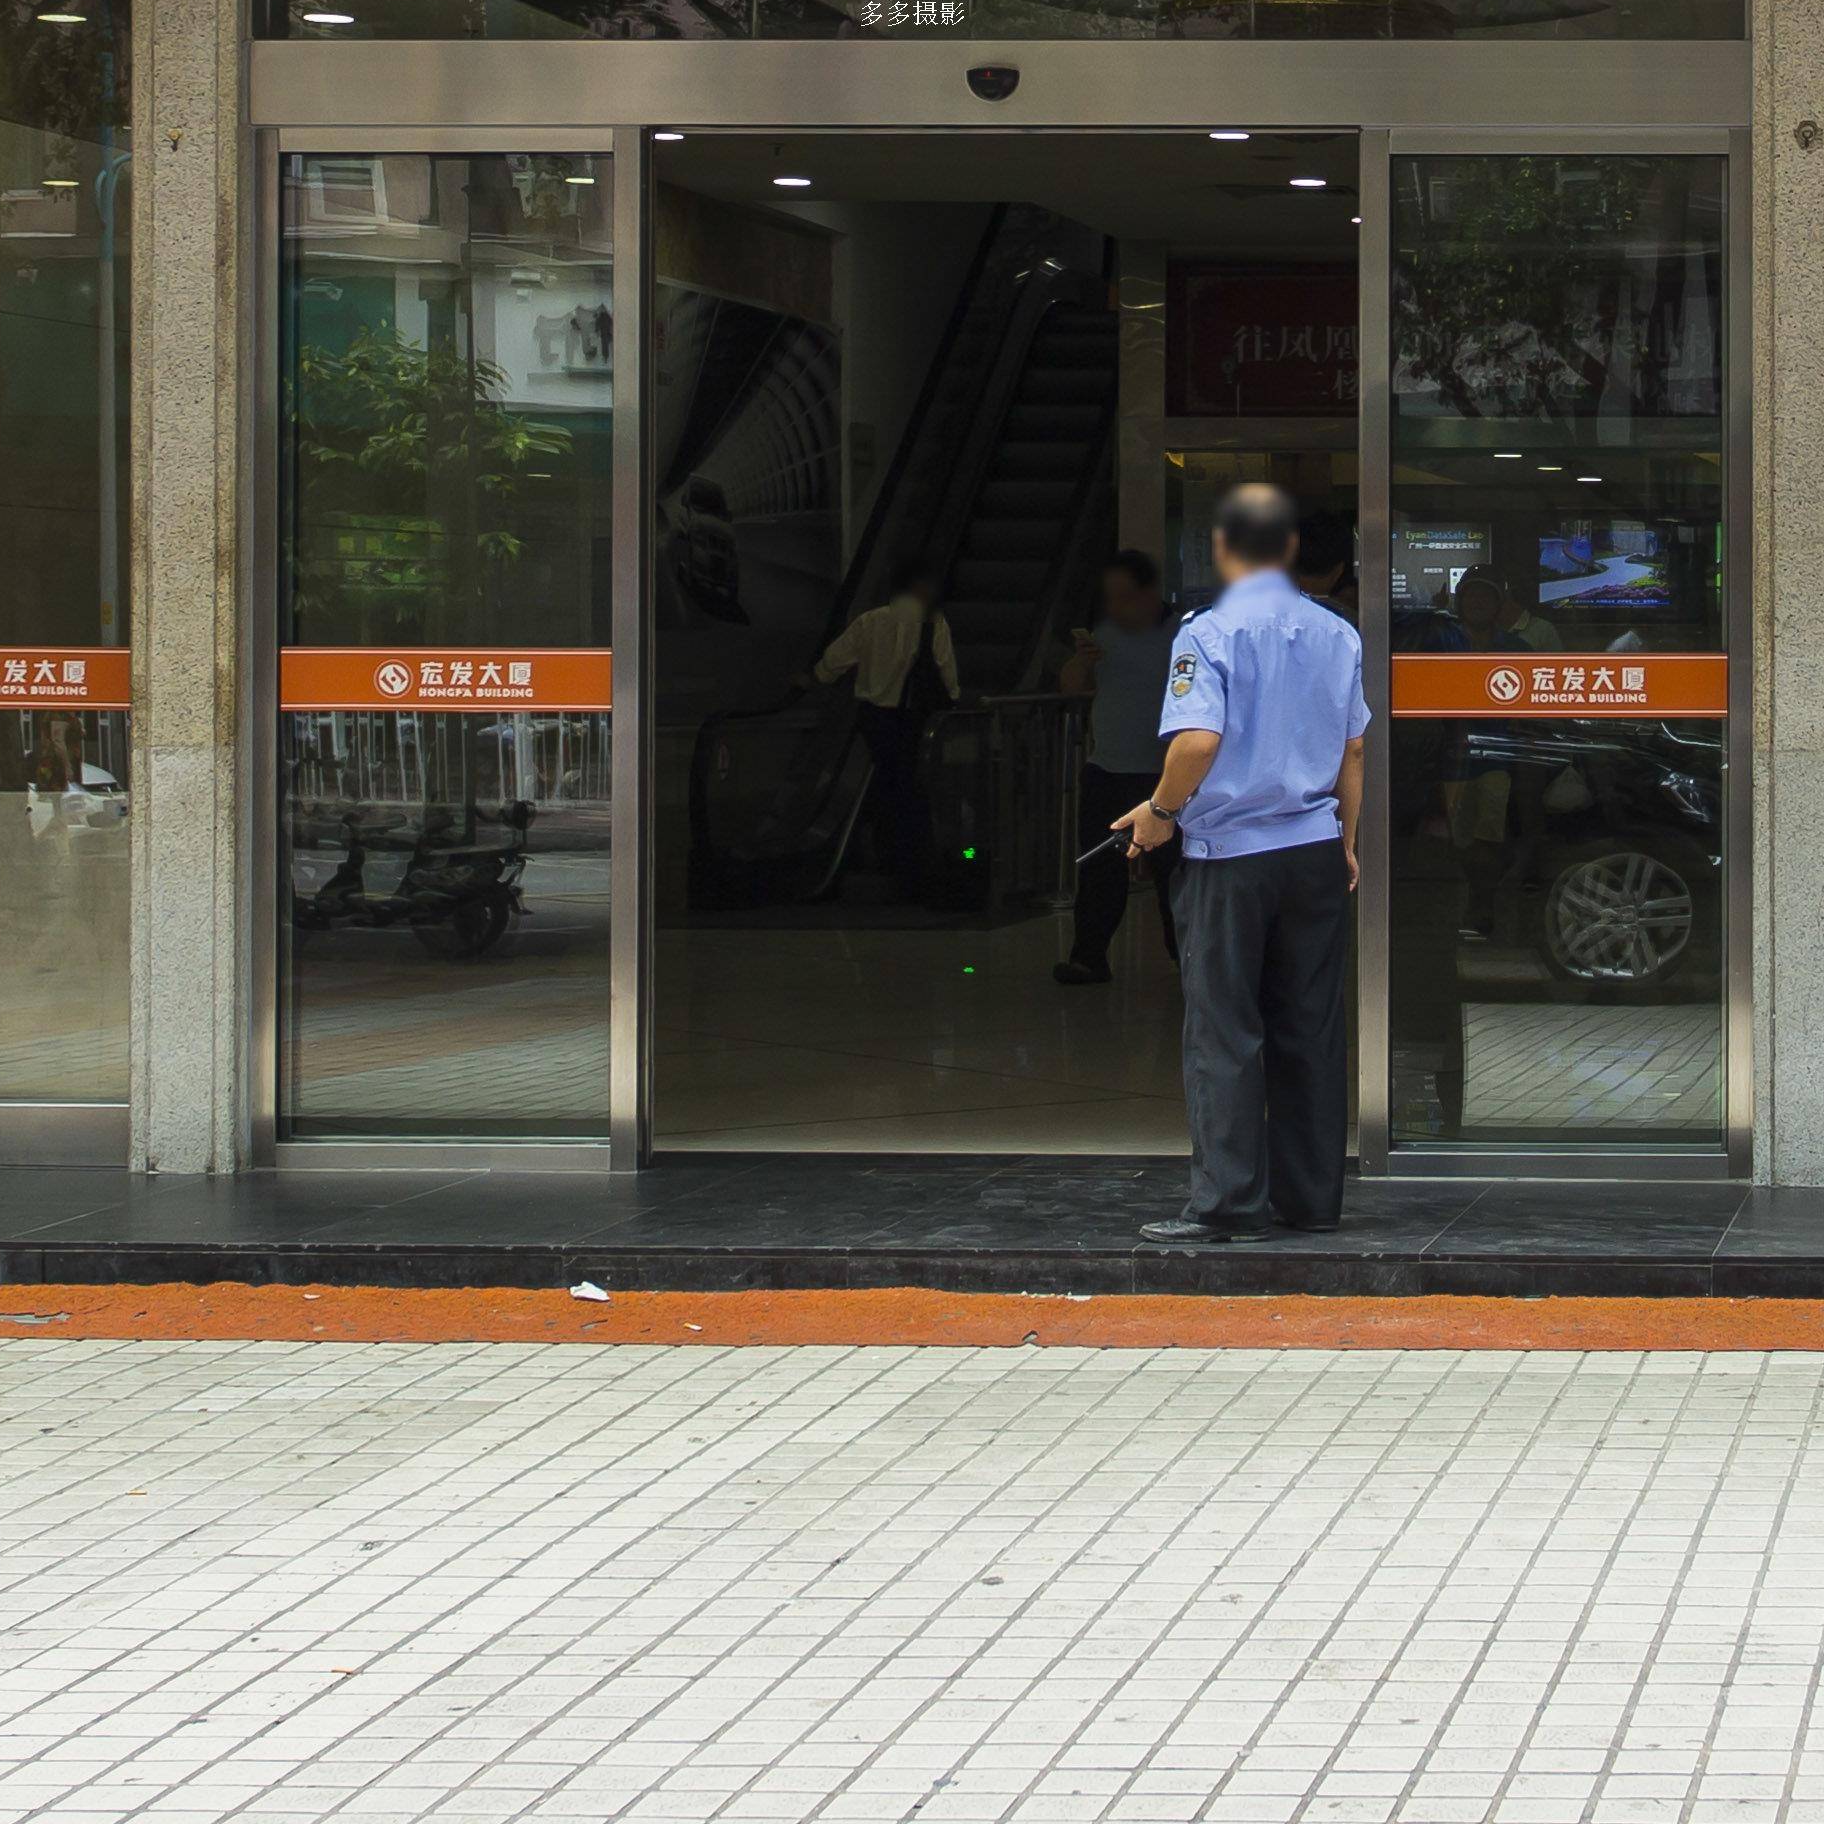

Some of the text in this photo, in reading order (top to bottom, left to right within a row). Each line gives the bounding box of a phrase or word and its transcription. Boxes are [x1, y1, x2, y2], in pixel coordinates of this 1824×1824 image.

[419, 661, 532, 686] 宏发大厦
[1531, 666, 1647, 692] 宏发大厦
[30, 685, 88, 696] BUILDING
[476, 688, 534, 698] BUILDING
[1589, 693, 1647, 703] BUILDING
